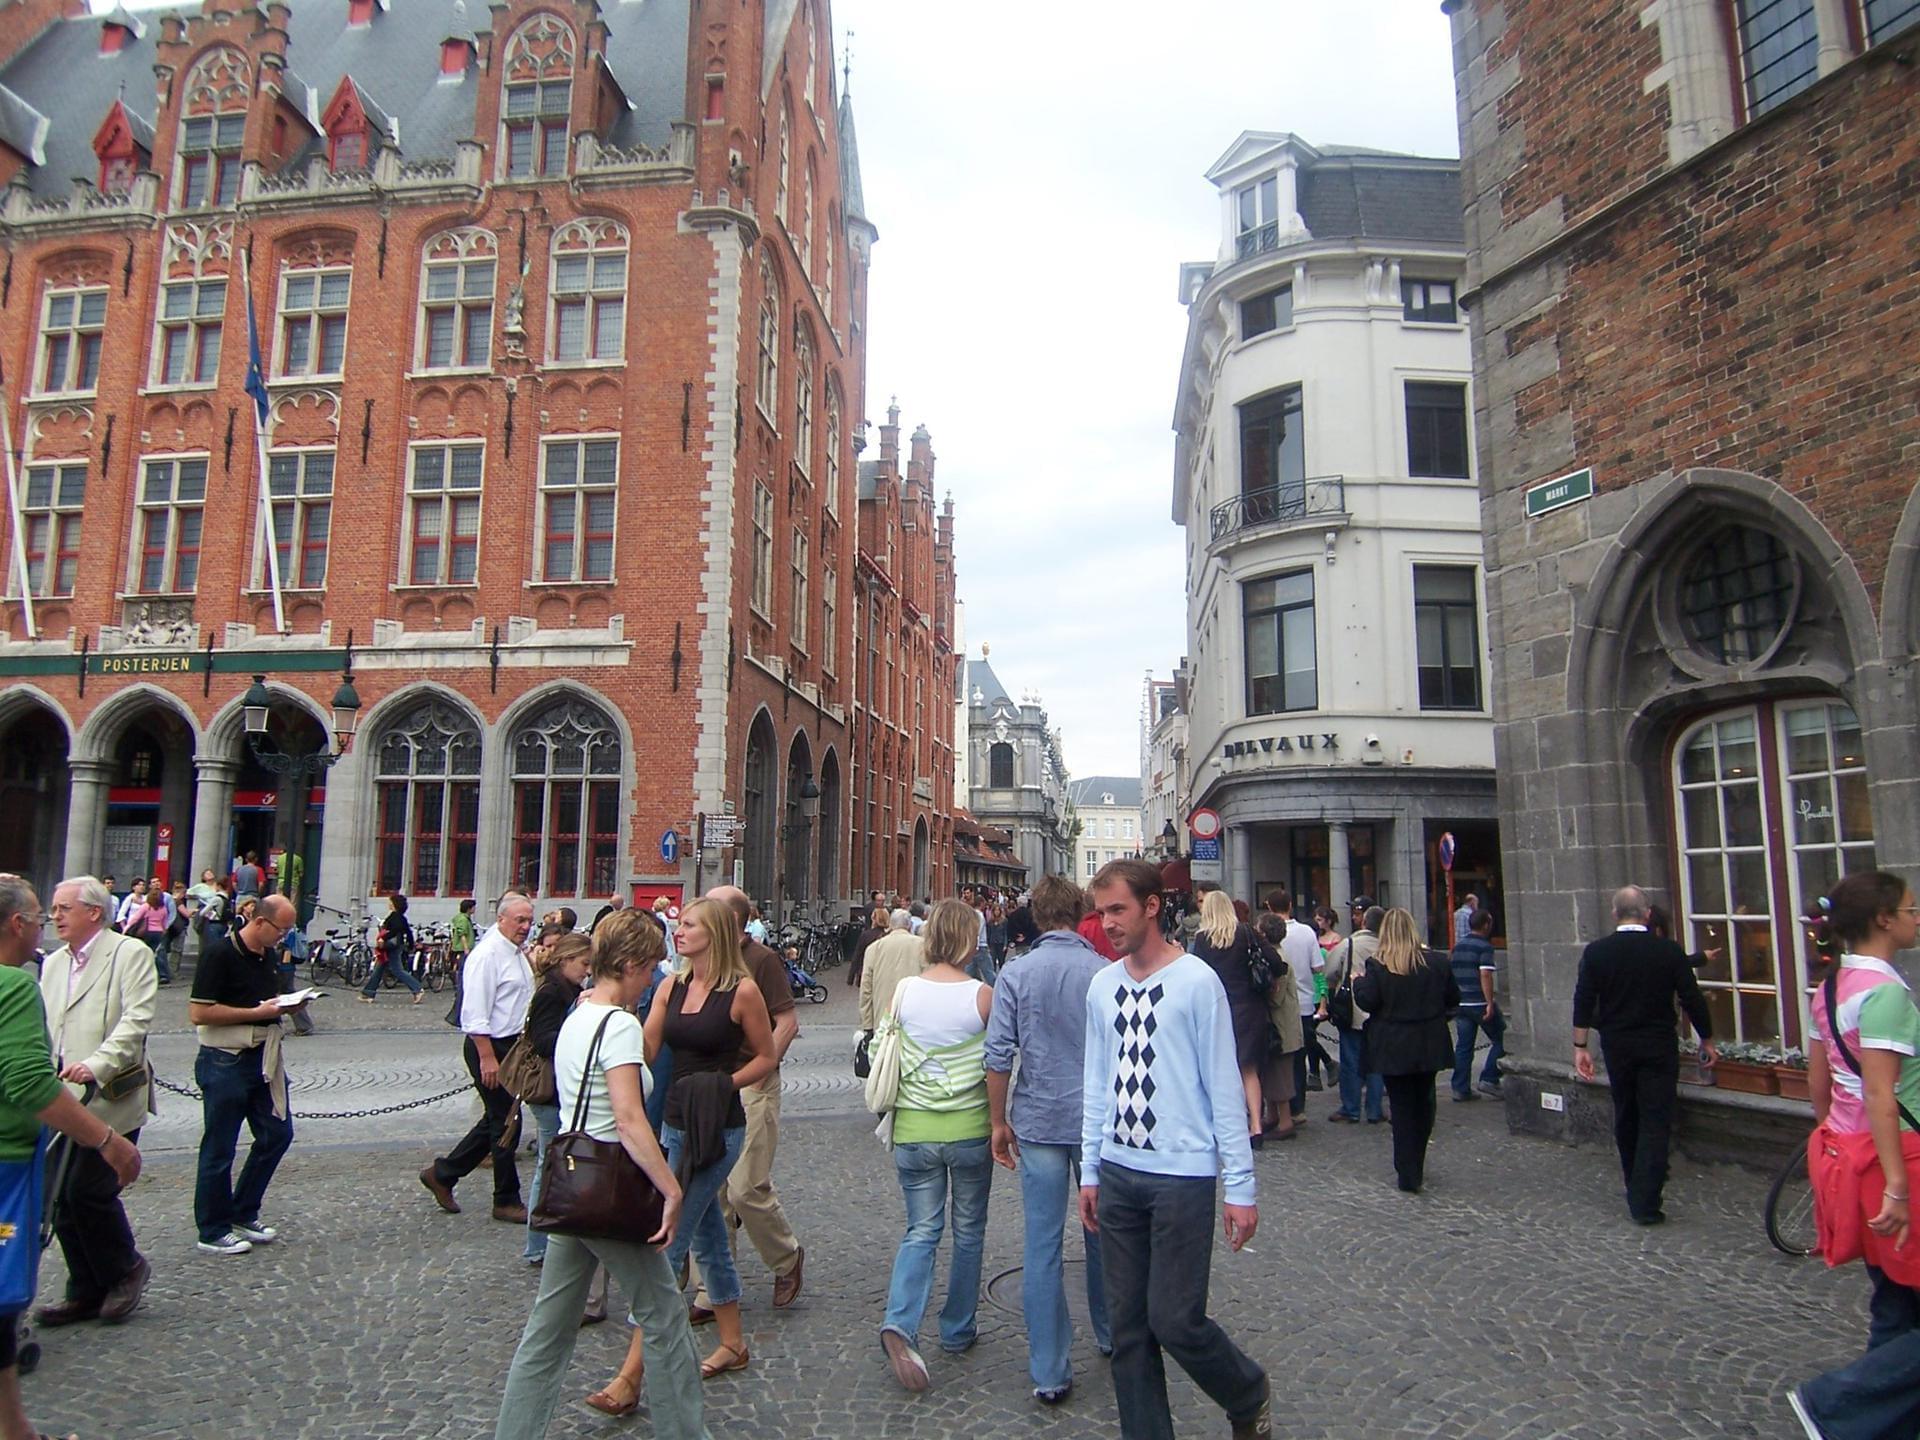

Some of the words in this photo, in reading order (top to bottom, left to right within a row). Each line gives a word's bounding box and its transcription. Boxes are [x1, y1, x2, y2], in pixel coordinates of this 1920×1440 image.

[1545, 485, 1568, 501] MARKT
[103, 657, 189, 672] POSTERIJEN
[1224, 733, 1339, 758] DELVAUX
